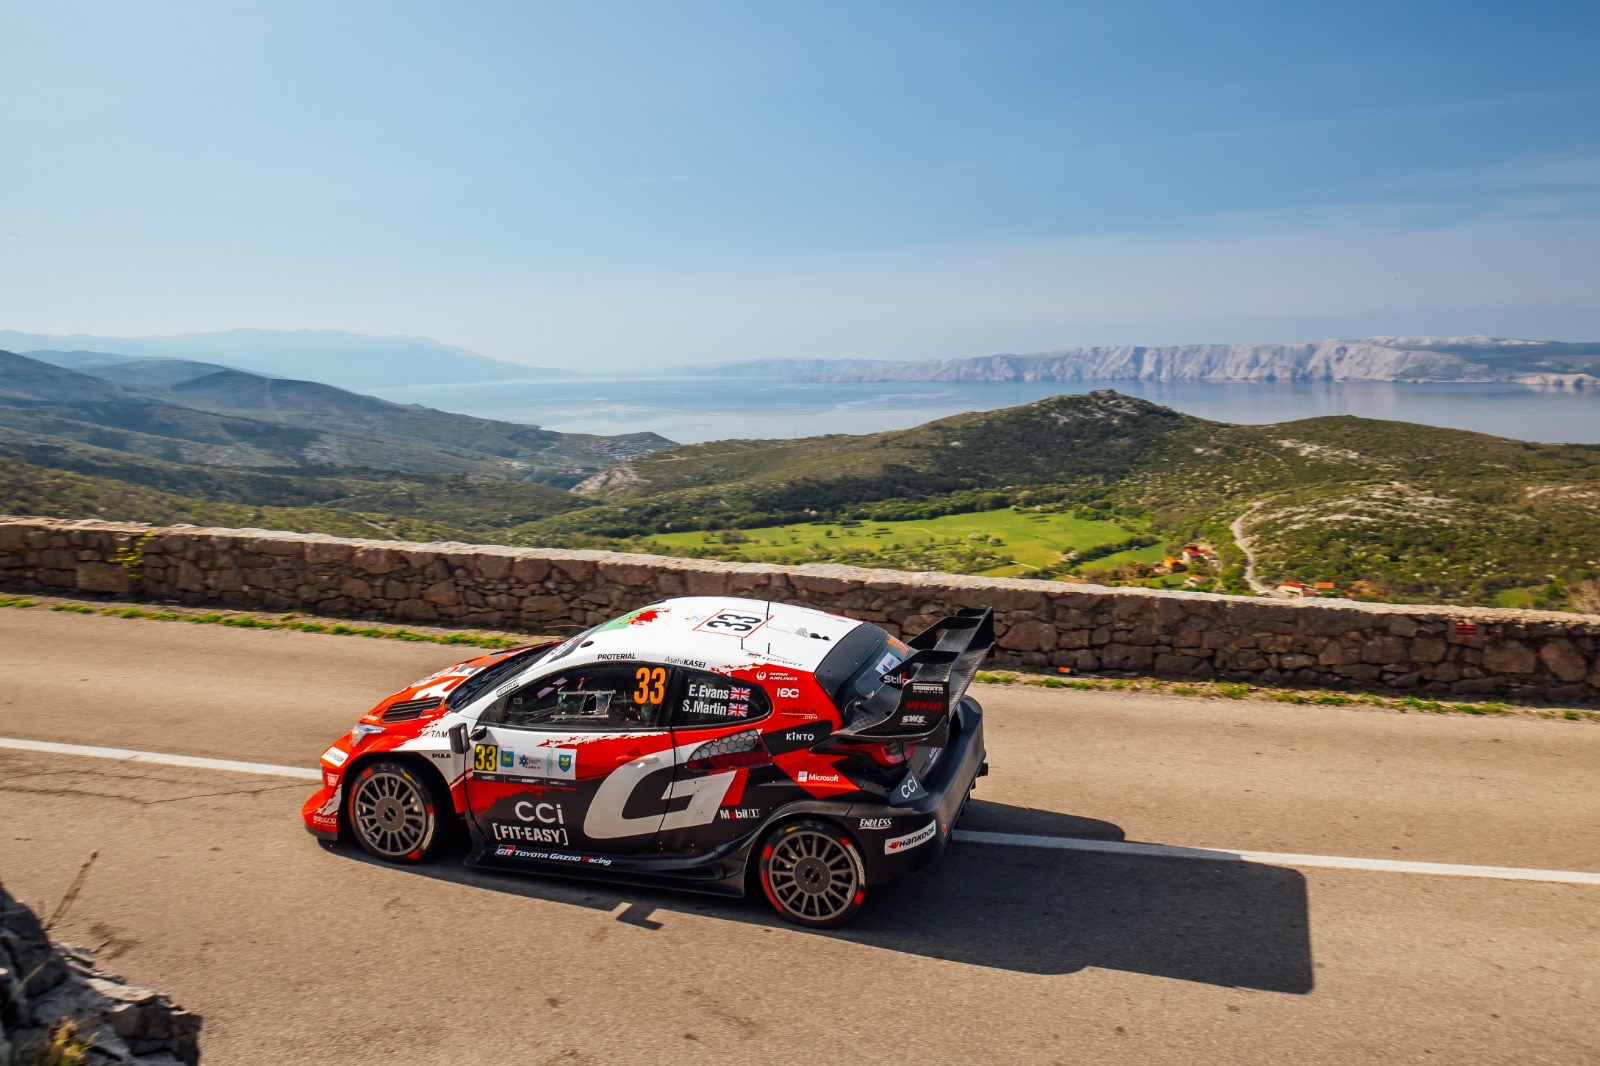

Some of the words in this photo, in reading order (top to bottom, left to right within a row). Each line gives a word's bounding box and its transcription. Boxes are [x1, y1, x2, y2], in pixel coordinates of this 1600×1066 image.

[706, 613, 762, 632] 33
[597, 652, 637, 661] PROTERIAL
[633, 667, 666, 705] 33
[688, 684, 730, 700] E.Evans
[682, 699, 727, 716] S.Martin
[906, 701, 943, 710] DENSO
[901, 714, 926, 724] SWS
[431, 730, 449, 738] TAM
[786, 731, 815, 741] KINTO
[475, 744, 497, 772] 33
[808, 773, 839, 782] Microsoft
[719, 808, 749, 819] Mobil
[859, 817, 892, 828] ENDLESS
[514, 850, 548, 859] TOYOTA
[549, 853, 582, 862] GAZOO
[582, 856, 612, 866] Racing
